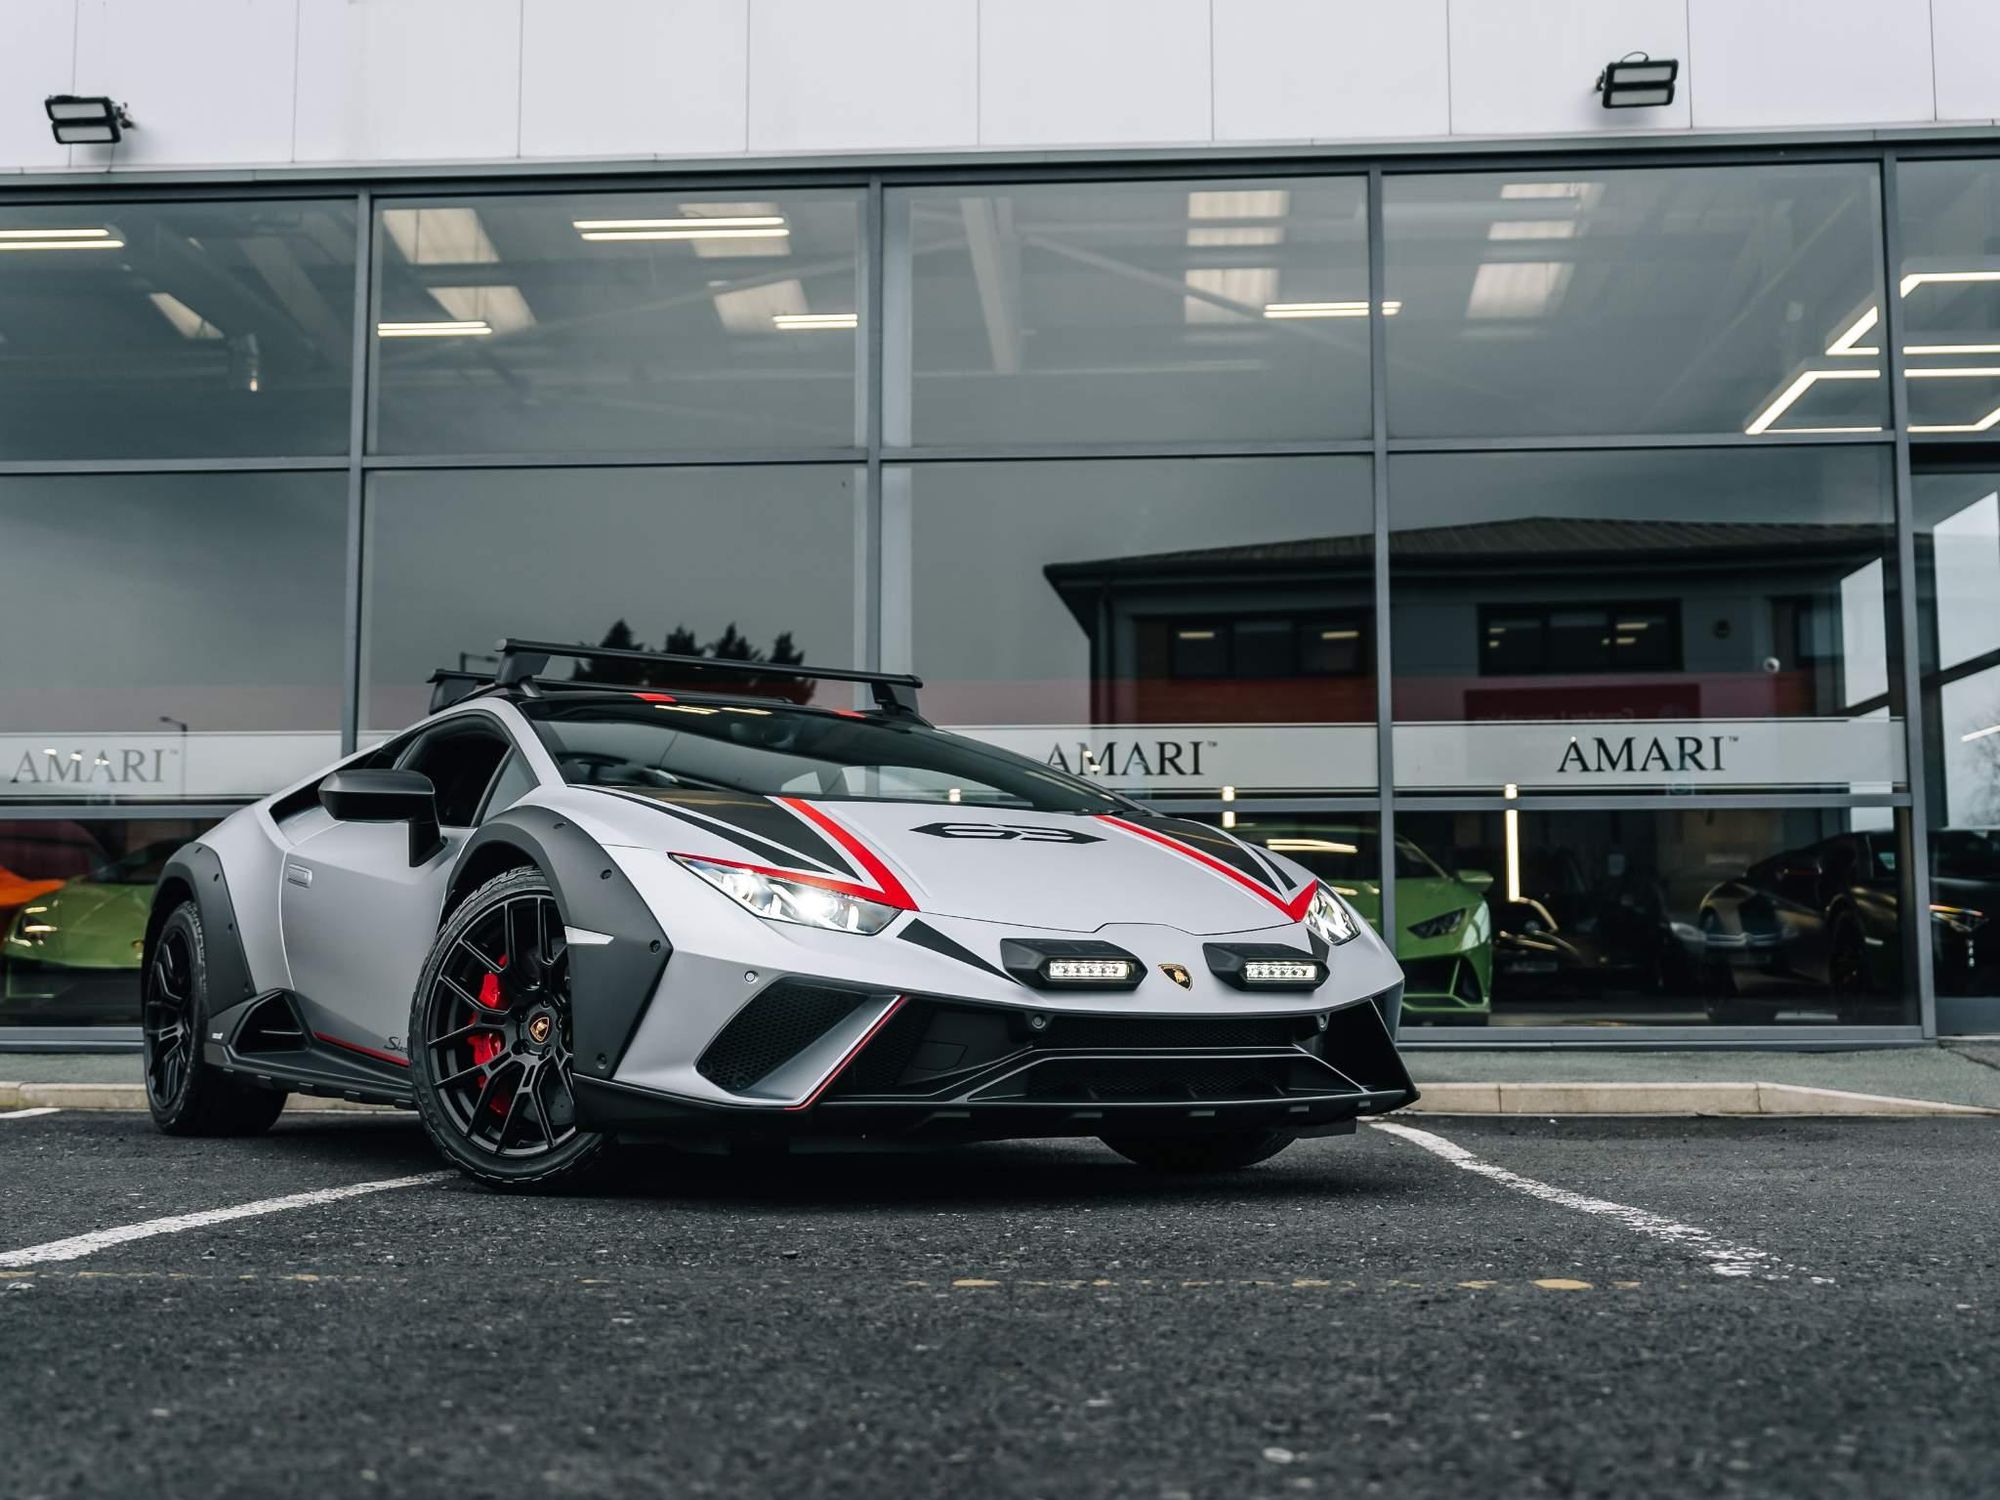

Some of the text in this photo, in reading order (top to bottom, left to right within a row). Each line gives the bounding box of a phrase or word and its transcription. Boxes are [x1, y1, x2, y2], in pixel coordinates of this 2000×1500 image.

[10, 749, 164, 783] AMARI
[1047, 741, 1205, 776] AMARI
[1557, 736, 1726, 772] AMARI
